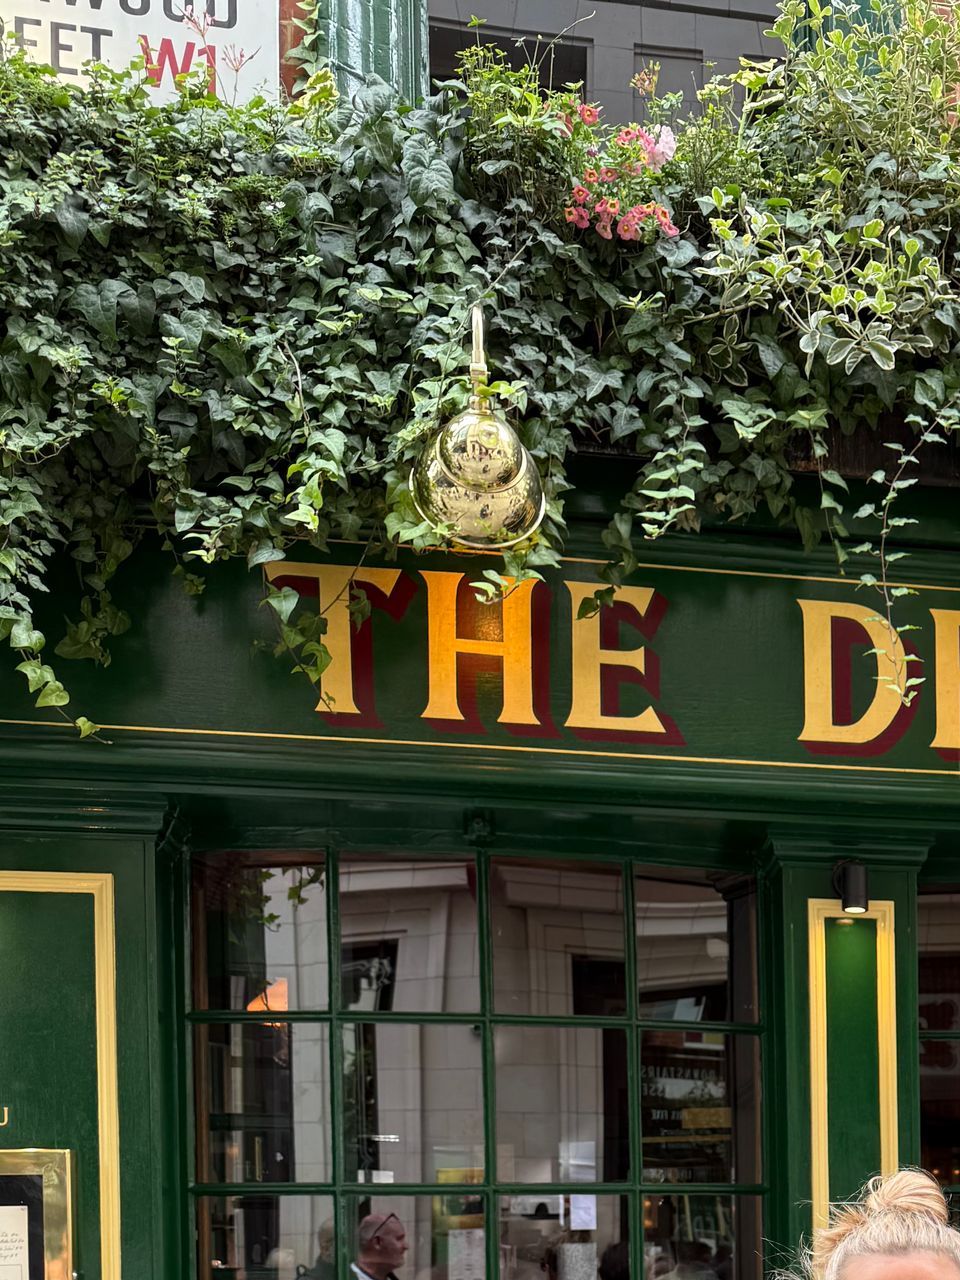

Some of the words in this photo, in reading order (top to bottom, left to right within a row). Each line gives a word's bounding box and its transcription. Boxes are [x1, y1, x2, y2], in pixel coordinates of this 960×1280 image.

[0, 16, 113, 76] EET
[138, 34, 217, 97] W1
[263, 561, 667, 734] THE
